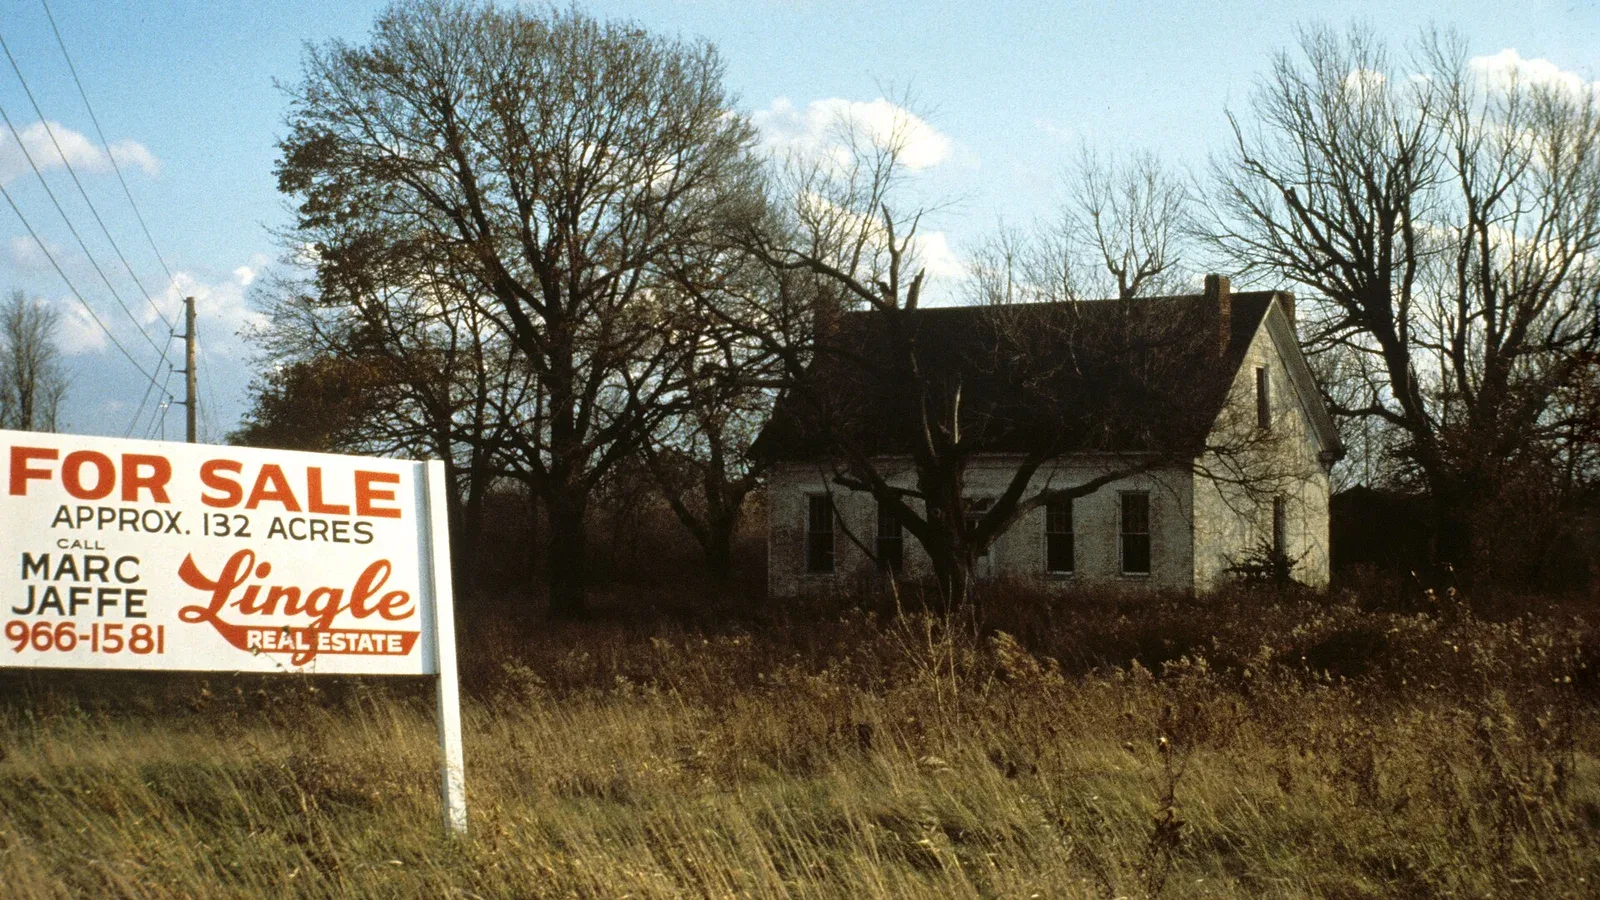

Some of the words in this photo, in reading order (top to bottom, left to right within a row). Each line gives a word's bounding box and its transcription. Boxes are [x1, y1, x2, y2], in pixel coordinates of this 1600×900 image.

[9, 445, 172, 504] FOR
[200, 458, 402, 519] SALE
[51, 505, 191, 535] APPROX.
[203, 512, 252, 538] 132
[267, 516, 374, 545] ACRES
[56, 538, 106, 551] CALL
[21, 552, 141, 584] MARC
[11, 585, 148, 618] JAFFE
[178, 548, 416, 667] Lingle
[4, 620, 165, 654] 966-1581
[247, 630, 311, 651] REAL
[317, 632, 403, 653] ESTATE
